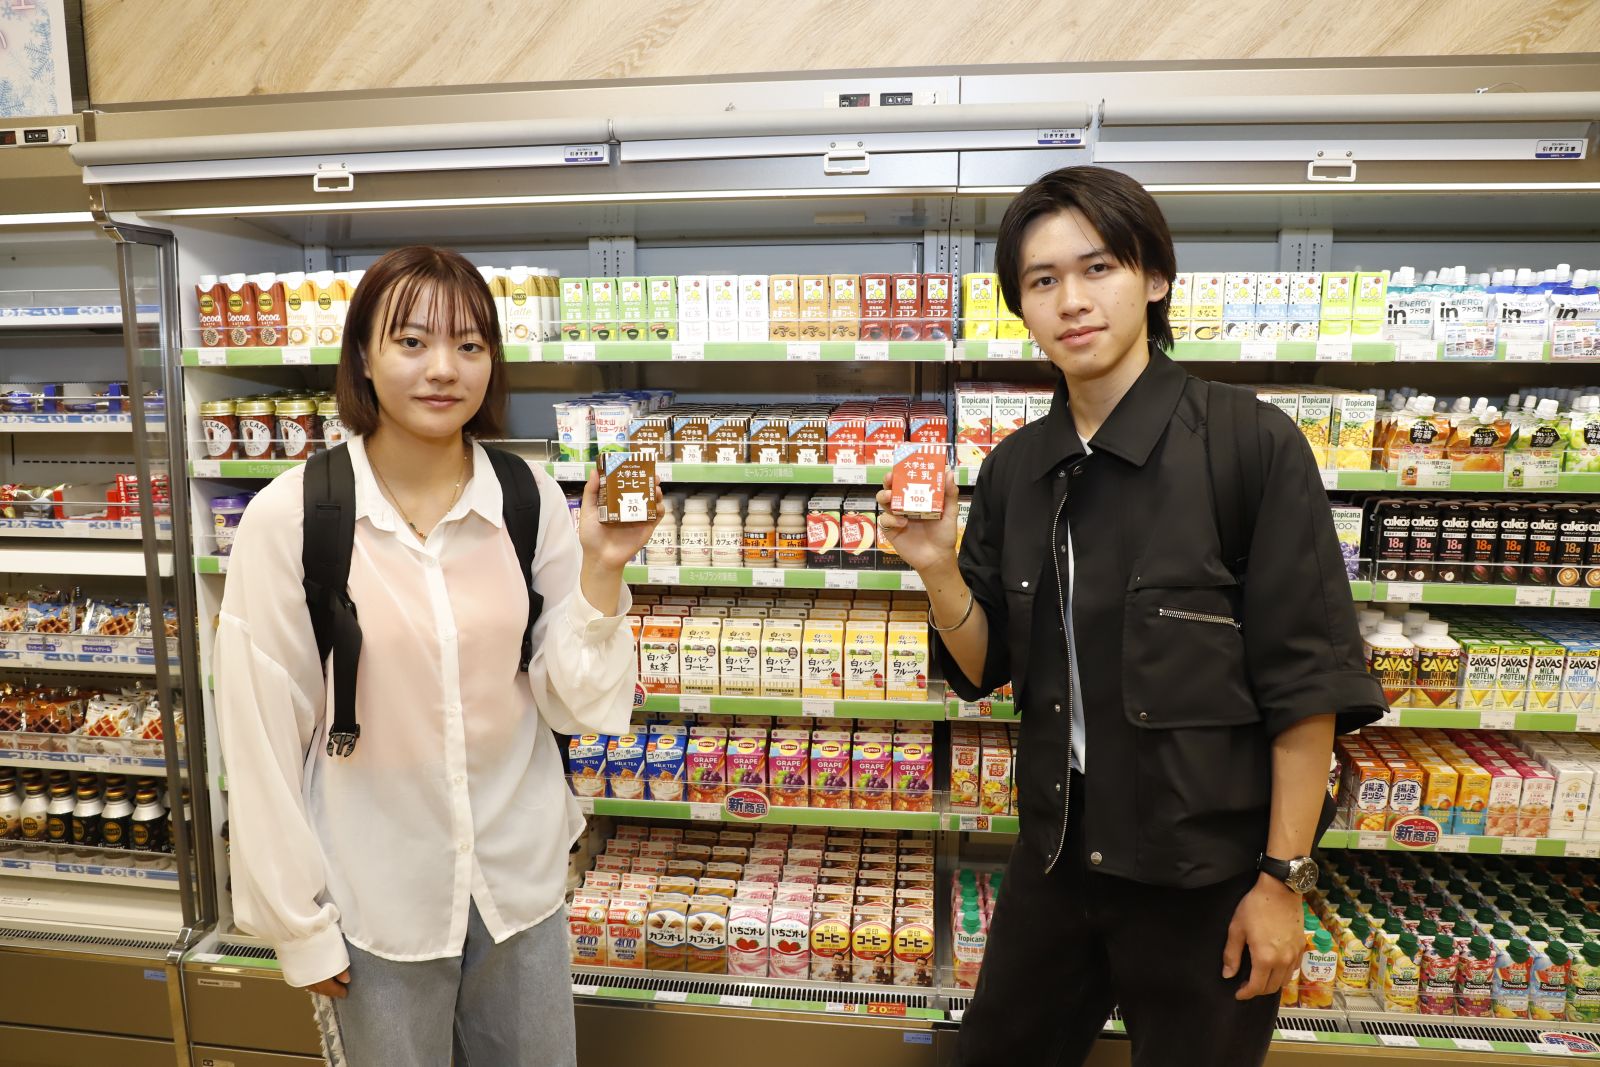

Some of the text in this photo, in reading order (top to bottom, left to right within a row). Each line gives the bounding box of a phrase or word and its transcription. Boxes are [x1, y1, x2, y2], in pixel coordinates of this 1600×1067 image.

[1388, 304, 1407, 324] in
[1440, 302, 1458, 321] in
[1502, 303, 1521, 323] in
[1557, 304, 1577, 319] in
[200, 313, 222, 322] Cocoa
[228, 312, 250, 322] Cocoa
[257, 312, 280, 321] Cocoa
[960, 396, 990, 404] Tropicana
[994, 396, 1023, 404] Tropicana
[1029, 396, 1052, 405] Tropica
[1302, 396, 1330, 404] Tropicana
[1345, 399, 1374, 407] Tropicana
[82, 414, 128, 423] COLD
[904, 462, 934, 470] 大学生協
[907, 471, 932, 480] 牛乳
[618, 479, 646, 488] コーヒー
[1332, 510, 1360, 519] Tropicana
[92, 655, 138, 664] COLD
[647, 653, 671, 661] 白バラ
[685, 655, 709, 663] 白バラ
[725, 656, 750, 665] 白バラ
[766, 657, 791, 666] 白バラ
[1470, 657, 1496, 666] SAVAS
[650, 662, 668, 671] 紅茶
[808, 658, 832, 666] 白バラ
[850, 659, 874, 667] 白バラ
[893, 660, 918, 668] 白バラ
[1374, 657, 1412, 671] SAVAS
[1421, 657, 1458, 672] SAVAS
[1501, 658, 1528, 667] SAVAS
[1535, 659, 1562, 668] SAVAS
[1570, 660, 1596, 669] SAVAS
[808, 666, 835, 674] フルーツ
[850, 667, 878, 675] フルーツ
[893, 668, 920, 676] フルーツ
[109, 757, 141, 765] OLD
[1364, 783, 1384, 793] 腸活
[1396, 784, 1417, 793] 腸活
[1361, 792, 1386, 800] ラッシー
[728, 798, 767, 814] 新商品
[1395, 825, 1436, 842] 新商品
[101, 868, 146, 878] COLD
[570, 923, 603, 936] ピルクル
[609, 926, 642, 938] ピルクル
[576, 936, 598, 946] 400
[816, 933, 845, 943] コーヒー
[857, 936, 887, 945] コーヒー
[958, 933, 985, 943] Tropicana
[614, 938, 637, 949] 400
[899, 938, 929, 948] コーヒー
[1544, 1036, 1598, 1052] 新商品
